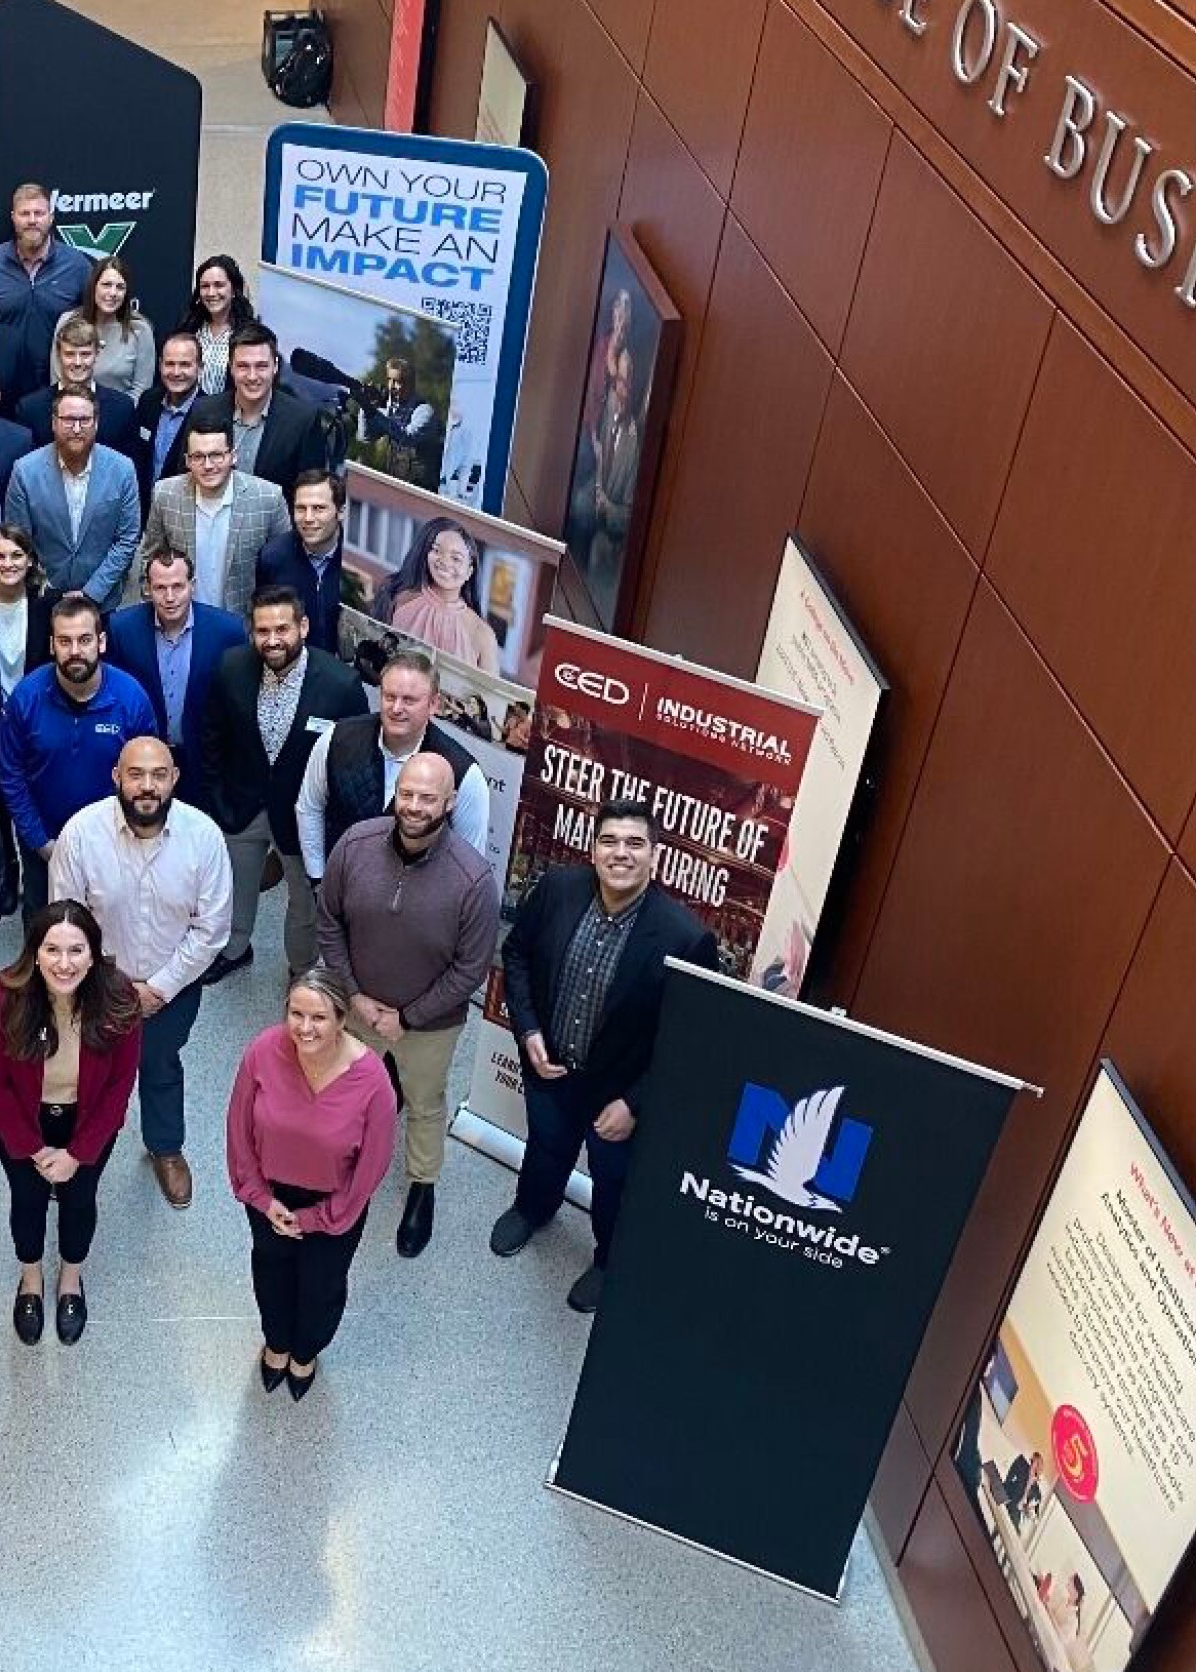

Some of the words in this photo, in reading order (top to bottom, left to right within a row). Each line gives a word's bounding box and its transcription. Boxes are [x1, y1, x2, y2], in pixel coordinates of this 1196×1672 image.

[952, 0, 1039, 116] OF
[297, 159, 389, 190] OWN
[401, 170, 507, 203] YOUR
[294, 184, 503, 234] FUTURE
[292, 212, 422, 255] MAKE
[432, 233, 499, 263] AN
[292, 243, 494, 292] IMPACT
[555, 662, 630, 705] CED
[656, 697, 792, 757] INDUSTRIAL
[656, 713, 726, 744] SOLUTIONS
[731, 739, 793, 767] NETWORK
[540, 744, 605, 803] STEER
[609, 768, 652, 803] THE
[653, 785, 737, 854] FUTURE
[736, 818, 769, 864] OF
[1130, 1162, 1161, 1220] What's
[1159, 1215, 1184, 1258] New
[704, 1206, 719, 1222] is
[724, 1217, 749, 1233] on
[754, 1228, 800, 1250] your
[803, 1246, 843, 1269] side
[1144, 1244, 1157, 1262] of
[1138, 1261, 1157, 1292] and
[1134, 1301, 1149, 1326] for
[1147, 1326, 1184, 1396] working
